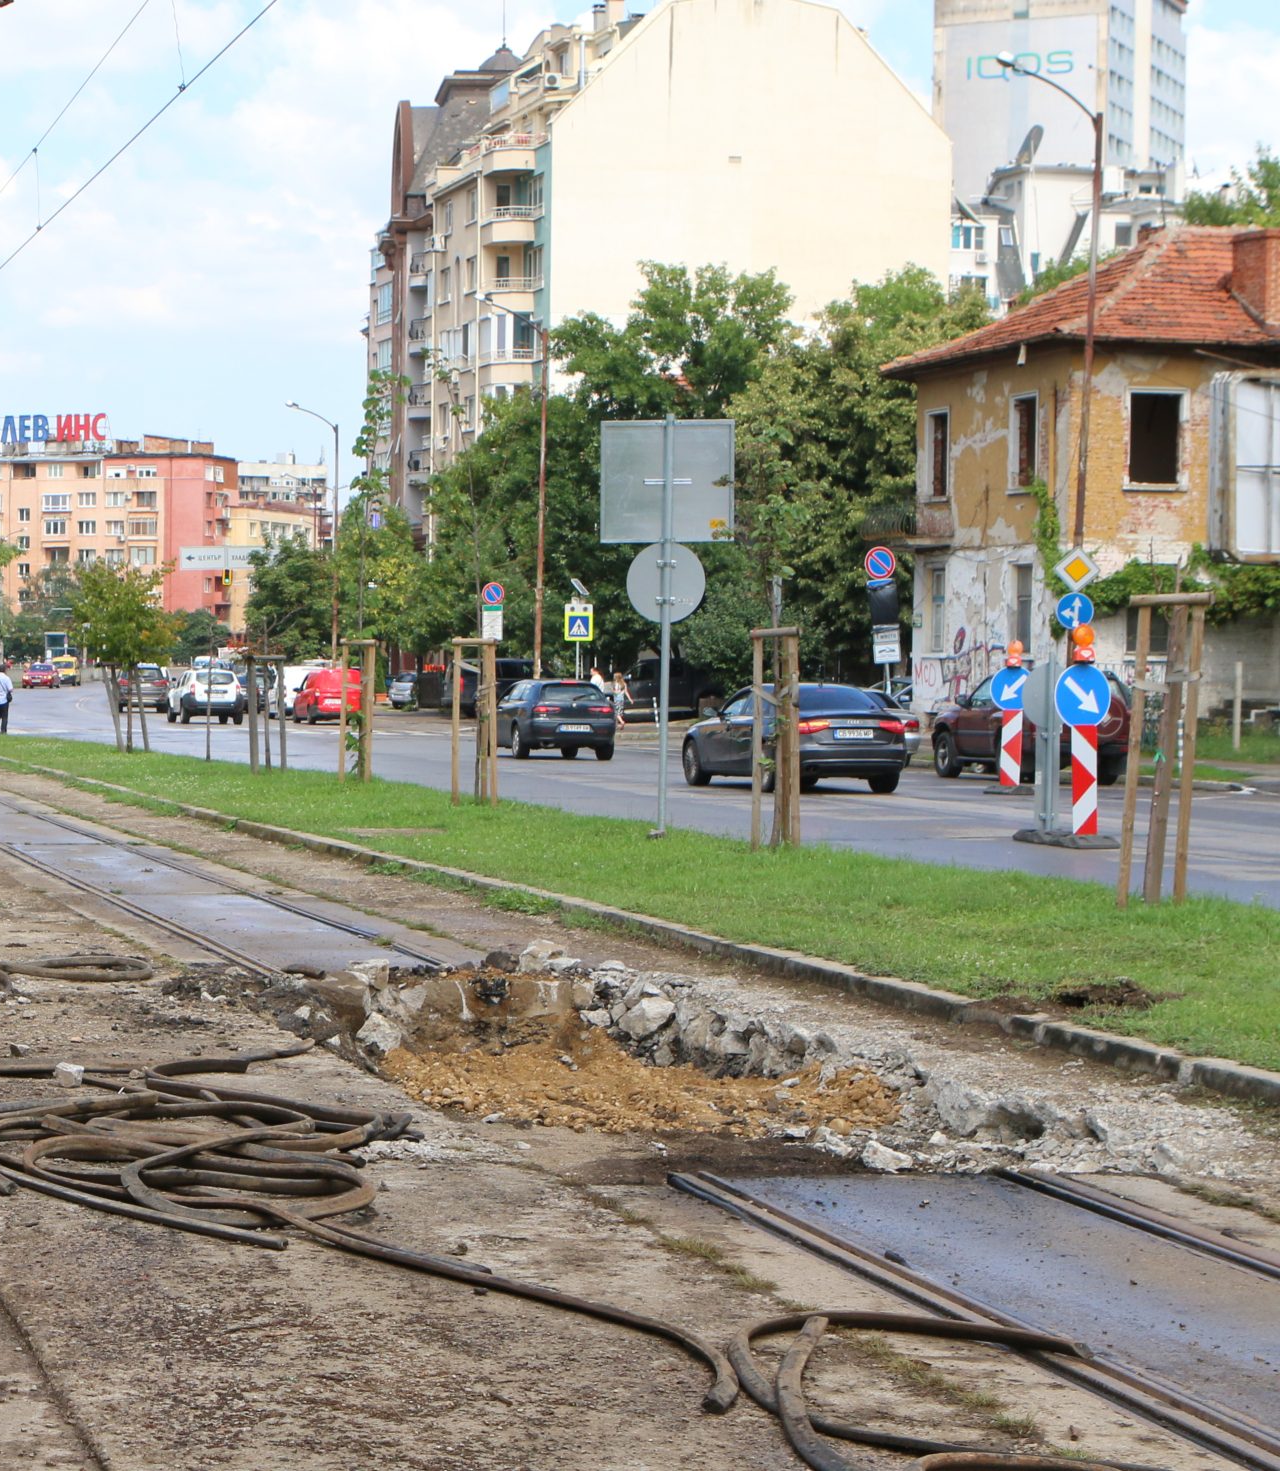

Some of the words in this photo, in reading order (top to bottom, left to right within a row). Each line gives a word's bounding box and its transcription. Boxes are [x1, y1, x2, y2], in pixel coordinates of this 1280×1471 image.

[966, 50, 1074, 82] IQOS
[1, 414, 50, 443] ЛЕВ
[56, 413, 107, 442] ИНС
